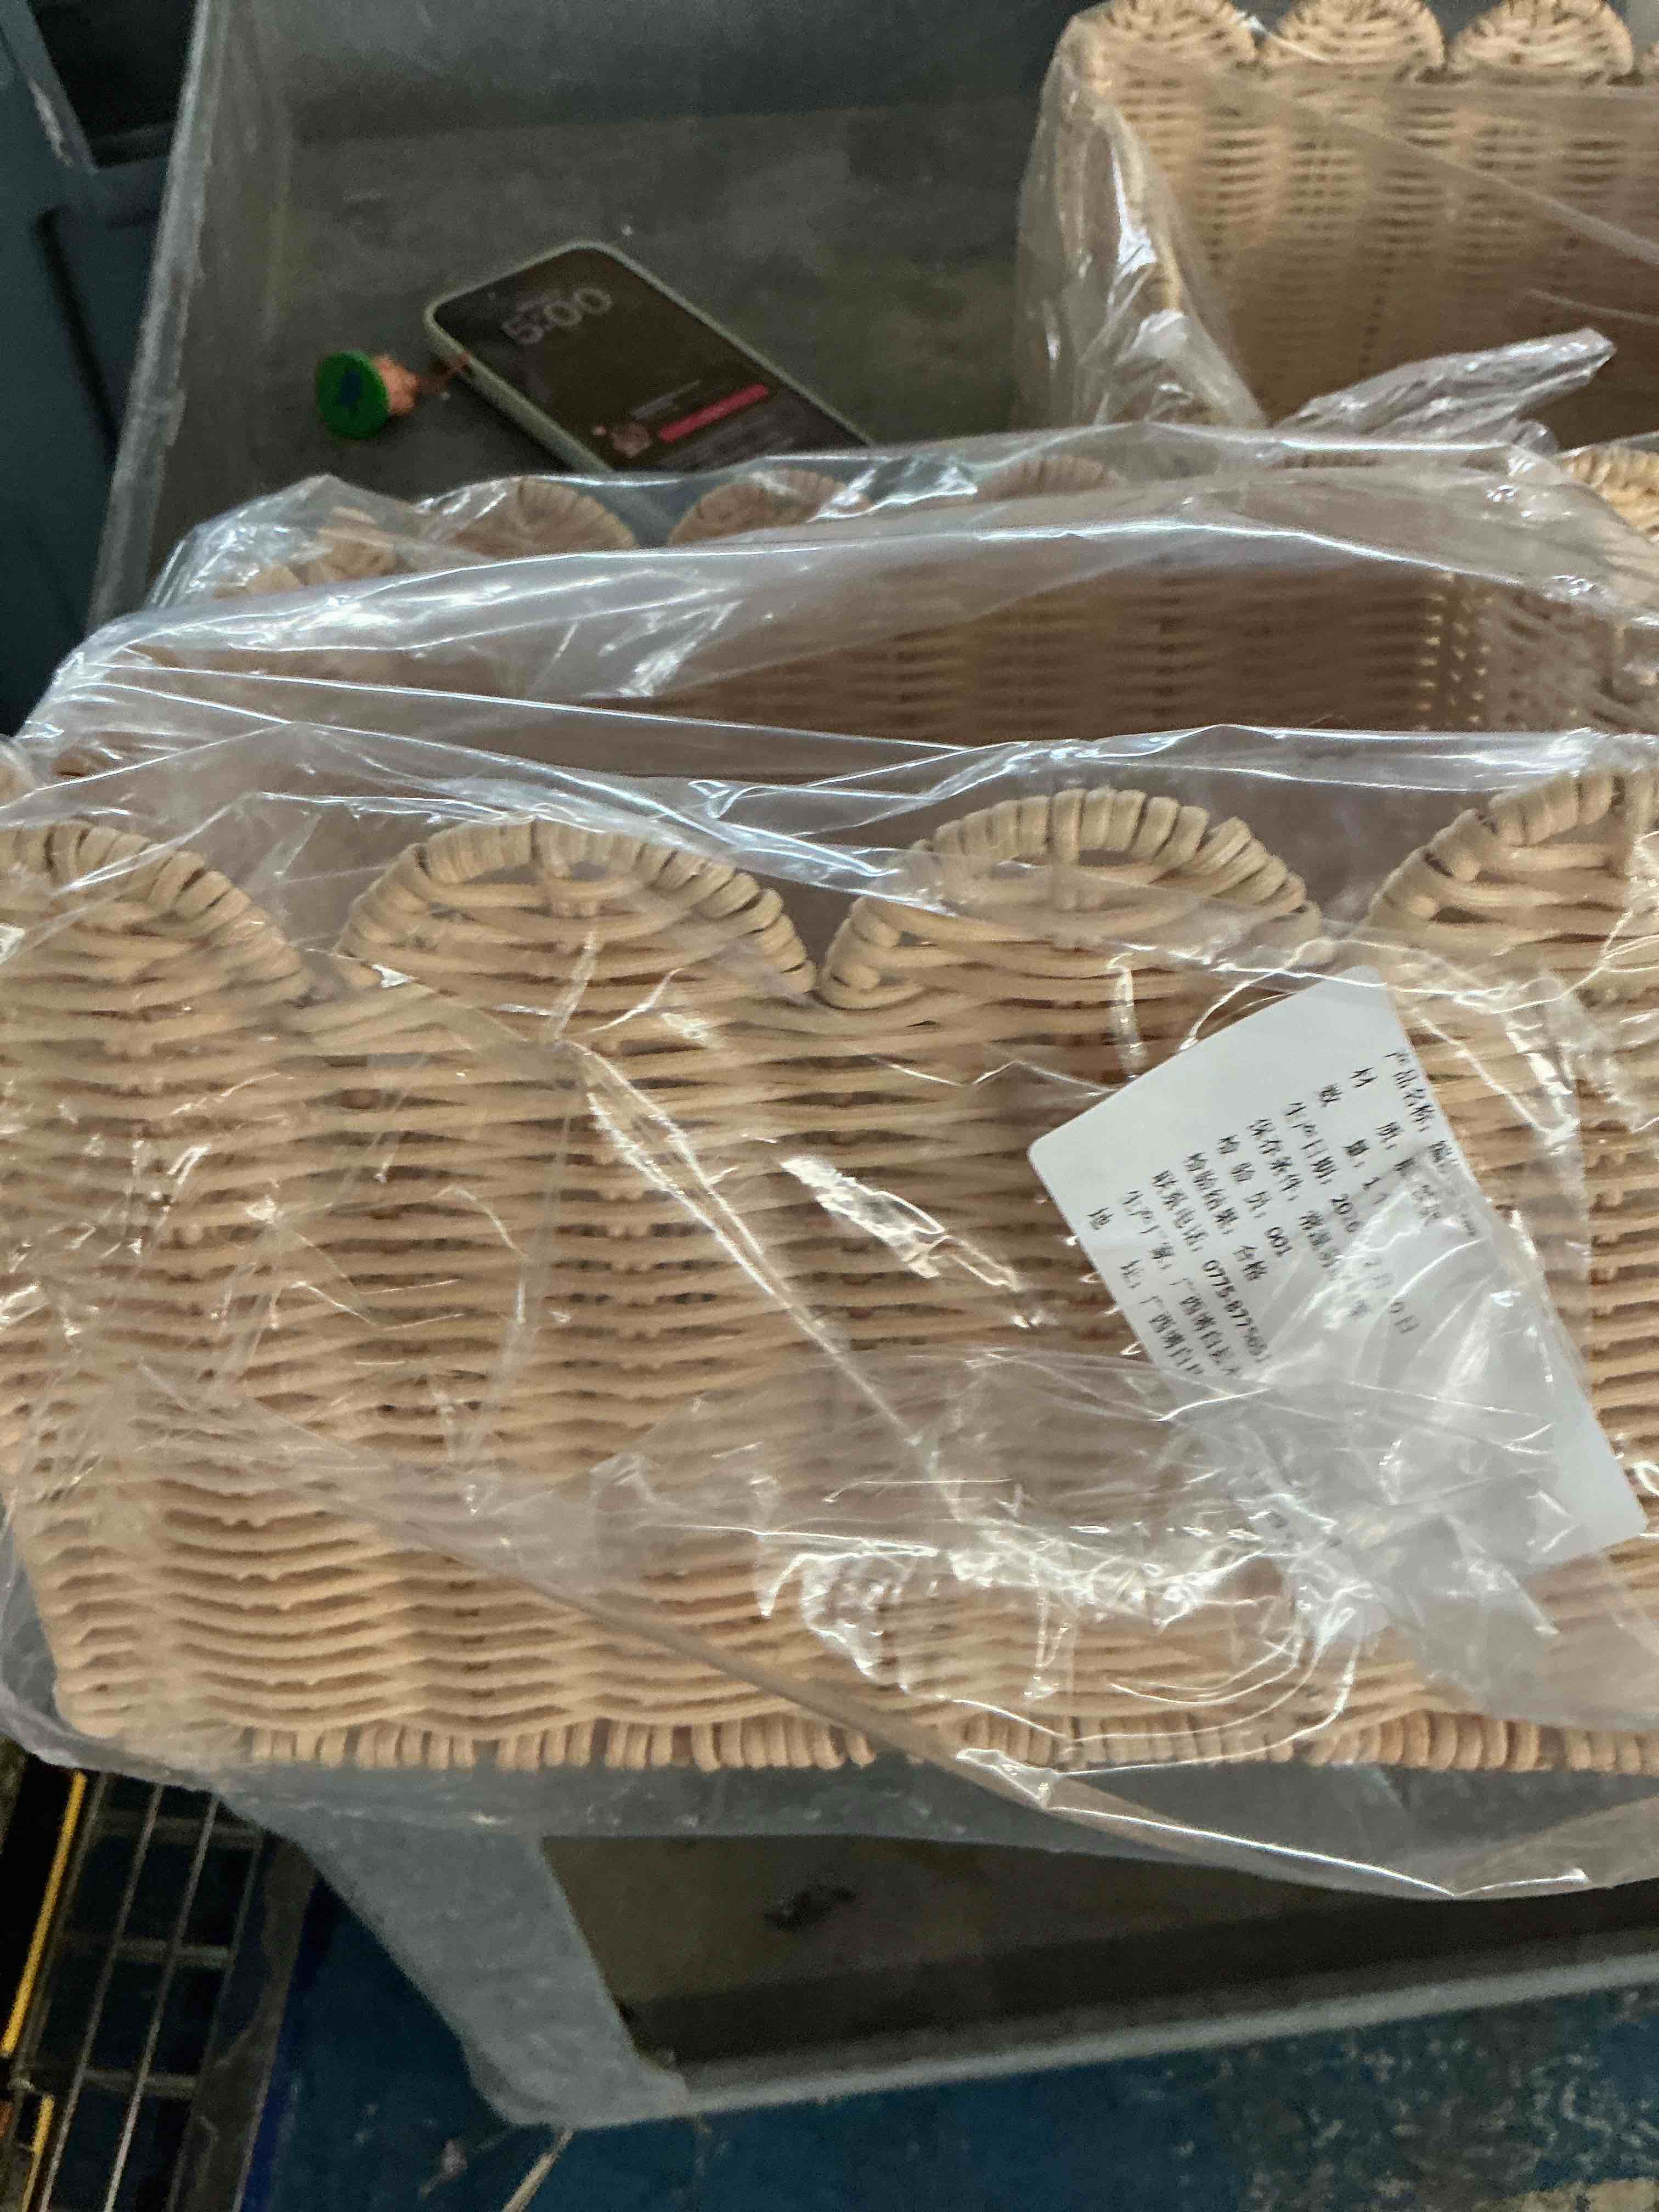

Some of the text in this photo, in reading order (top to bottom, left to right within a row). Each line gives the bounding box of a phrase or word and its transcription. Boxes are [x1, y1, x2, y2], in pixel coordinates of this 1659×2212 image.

[1350, 1067, 1378, 1088] 材
[1318, 1085, 1343, 1108] 数
[1087, 1207, 1114, 1231] 地
[1264, 1226, 1293, 1257] 001
[1232, 1245, 1268, 1282] 合格
